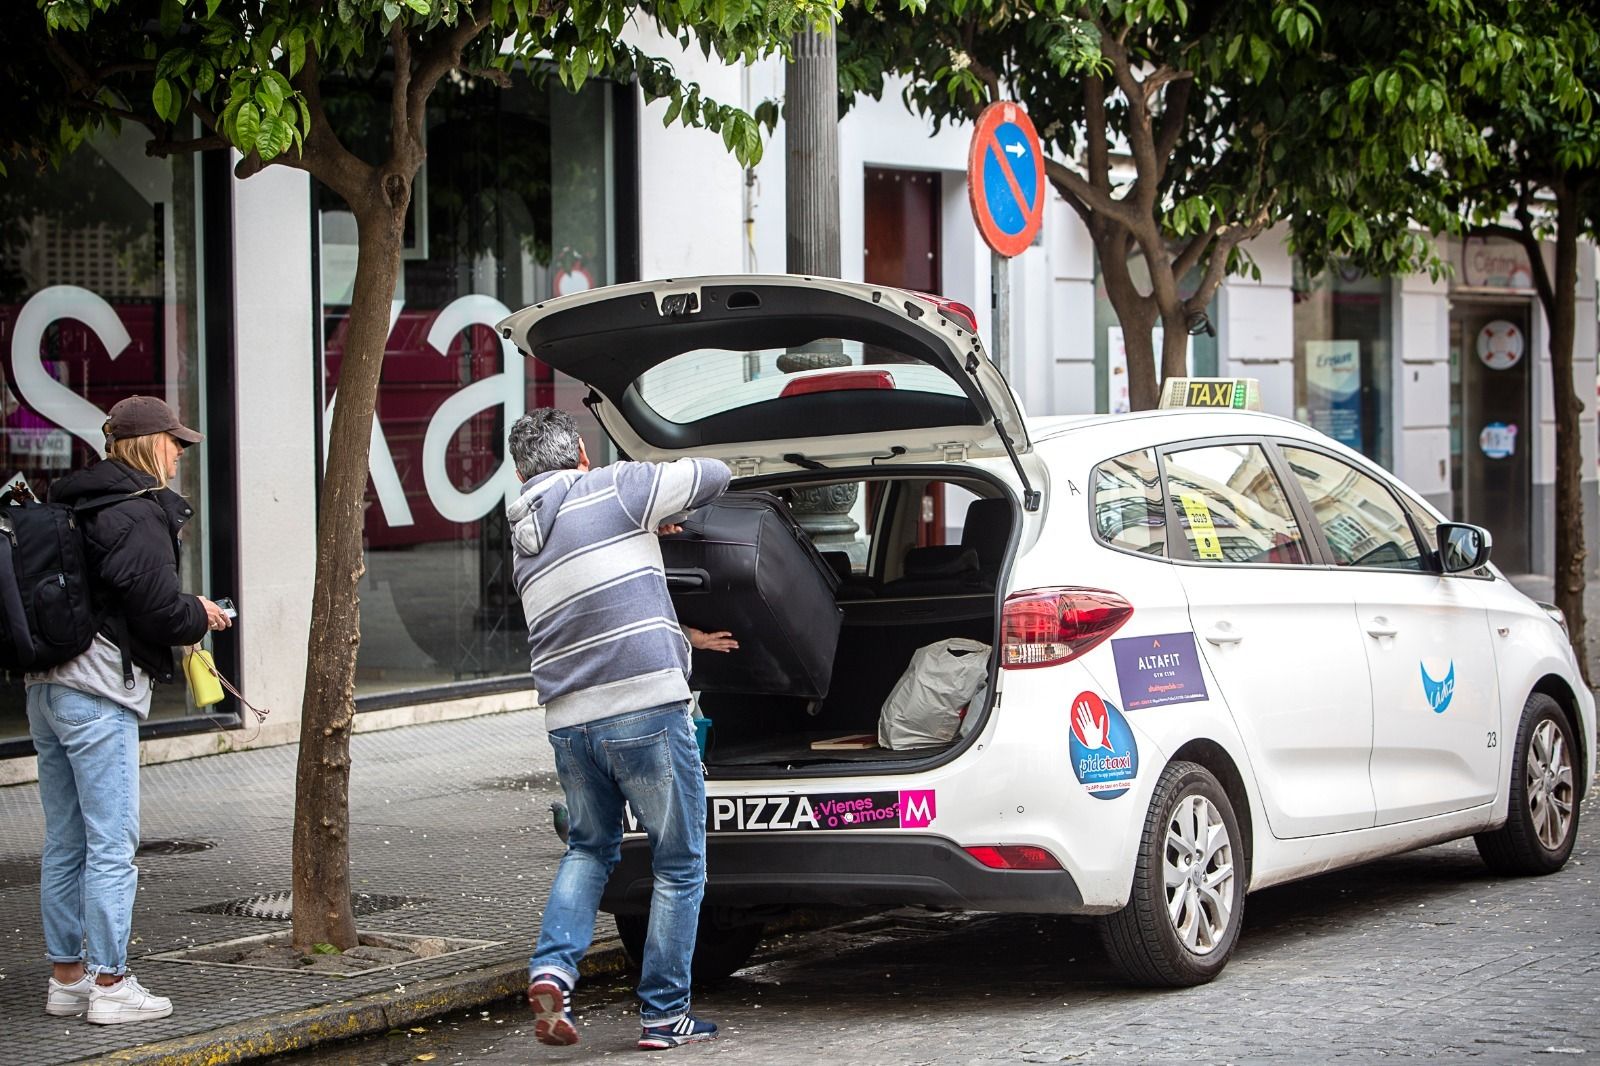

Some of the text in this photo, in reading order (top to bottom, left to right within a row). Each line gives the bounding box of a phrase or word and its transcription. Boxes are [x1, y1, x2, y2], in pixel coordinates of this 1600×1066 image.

[1189, 383, 1233, 406] TAXI
[1067, 479, 1081, 496] A
[1191, 513, 1208, 523] 2019
[1139, 654, 1180, 670] ALTAFIT
[1487, 731, 1497, 748] 23
[1080, 751, 1131, 778] pidetaxi
[713, 796, 820, 831] PIZZA
[905, 796, 931, 821] M
[828, 816, 838, 827] o
